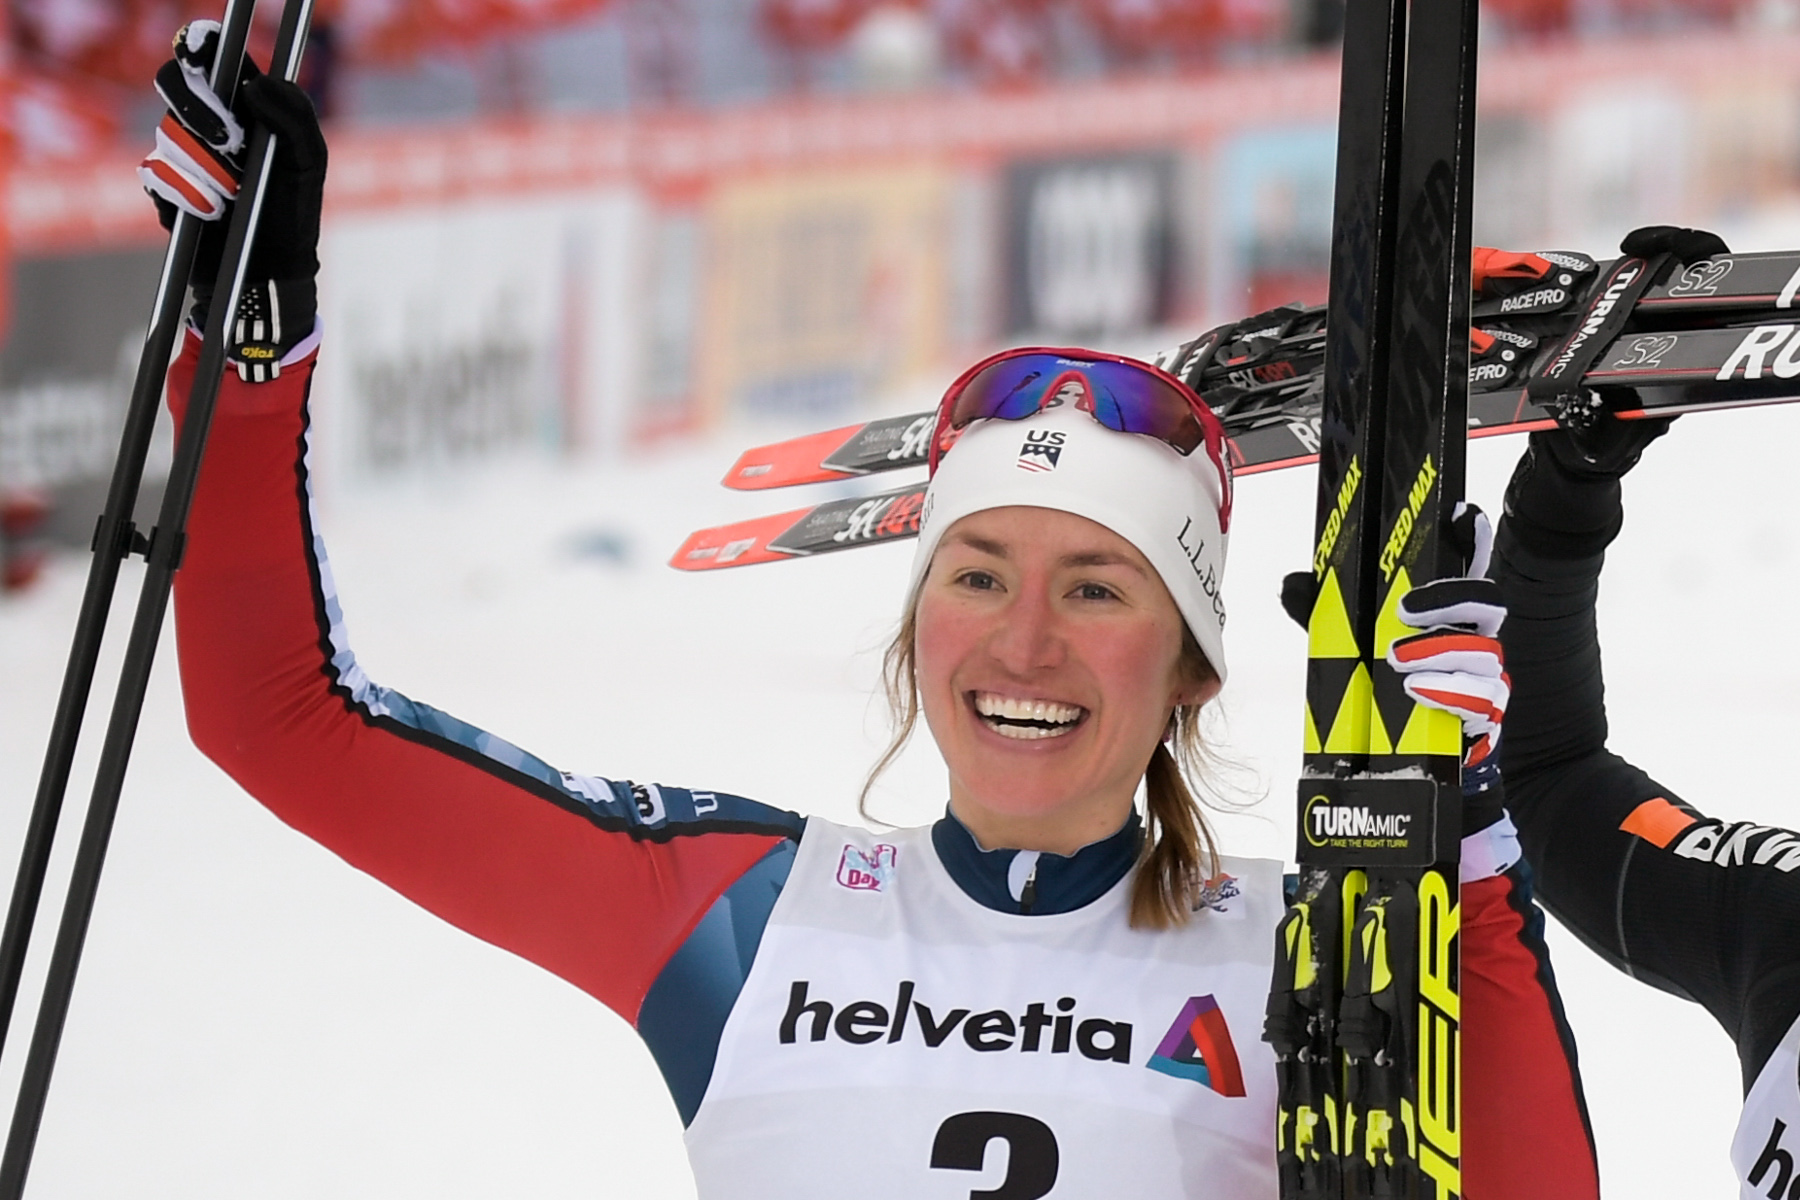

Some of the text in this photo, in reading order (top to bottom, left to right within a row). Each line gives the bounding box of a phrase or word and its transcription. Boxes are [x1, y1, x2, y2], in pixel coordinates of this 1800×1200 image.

[1500, 288, 1566, 313] RACE PRO
[1026, 429, 1068, 446] US
[1311, 805, 1408, 838] TURNAMIC
[778, 979, 1134, 1066] helvetia
